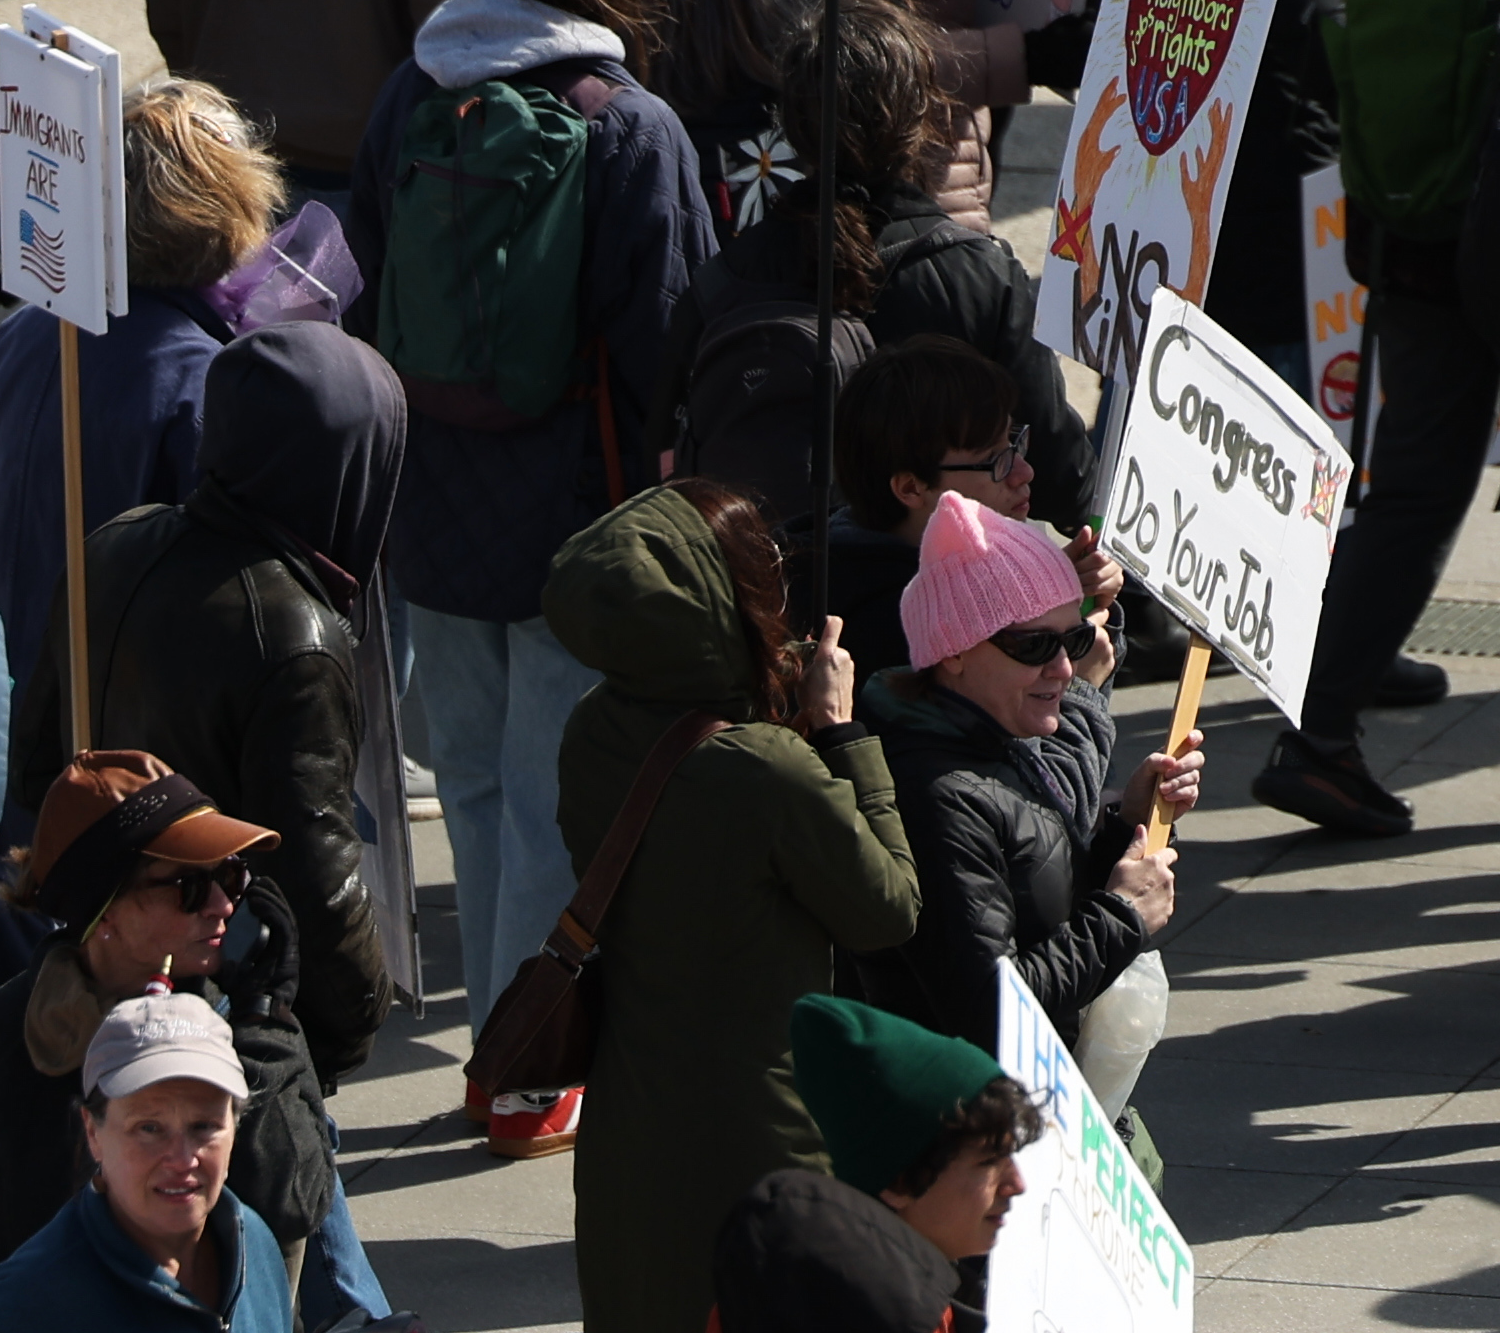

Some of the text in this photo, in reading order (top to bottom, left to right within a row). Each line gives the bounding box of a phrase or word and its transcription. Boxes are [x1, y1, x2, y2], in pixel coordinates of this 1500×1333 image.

[1129, 6, 1216, 80] jobs rights
[0, 86, 86, 164] IMMIGRANTS
[1135, 64, 1188, 144] USA
[27, 160, 59, 207] ARE
[1148, 323, 1298, 517] Congress
[1113, 453, 1277, 673] Do Your Job.
[1006, 974, 1071, 1133] THE
[1079, 1087, 1191, 1310] PERFECT
